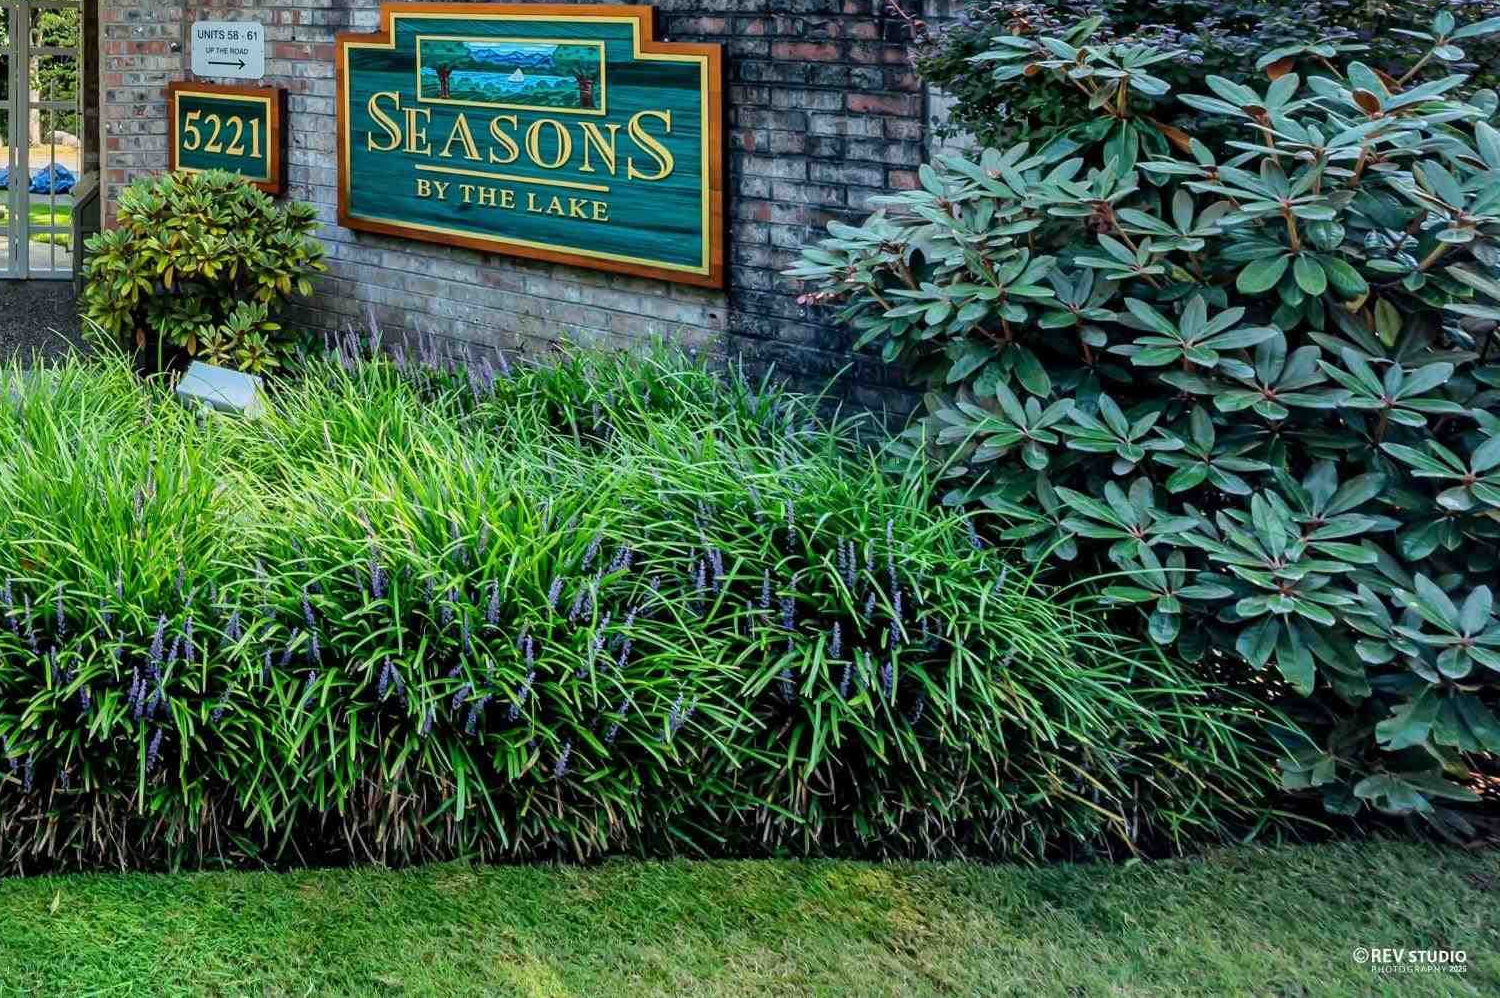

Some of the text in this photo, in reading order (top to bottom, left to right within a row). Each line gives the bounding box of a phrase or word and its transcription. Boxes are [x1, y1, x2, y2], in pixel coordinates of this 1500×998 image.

[197, 29, 225, 40] UNITS
[246, 30, 258, 41] 61
[229, 47, 249, 55] ROAD
[183, 109, 263, 158] 5221
[367, 90, 675, 181] SEASONS
[416, 178, 610, 222] BY THE LAKE
